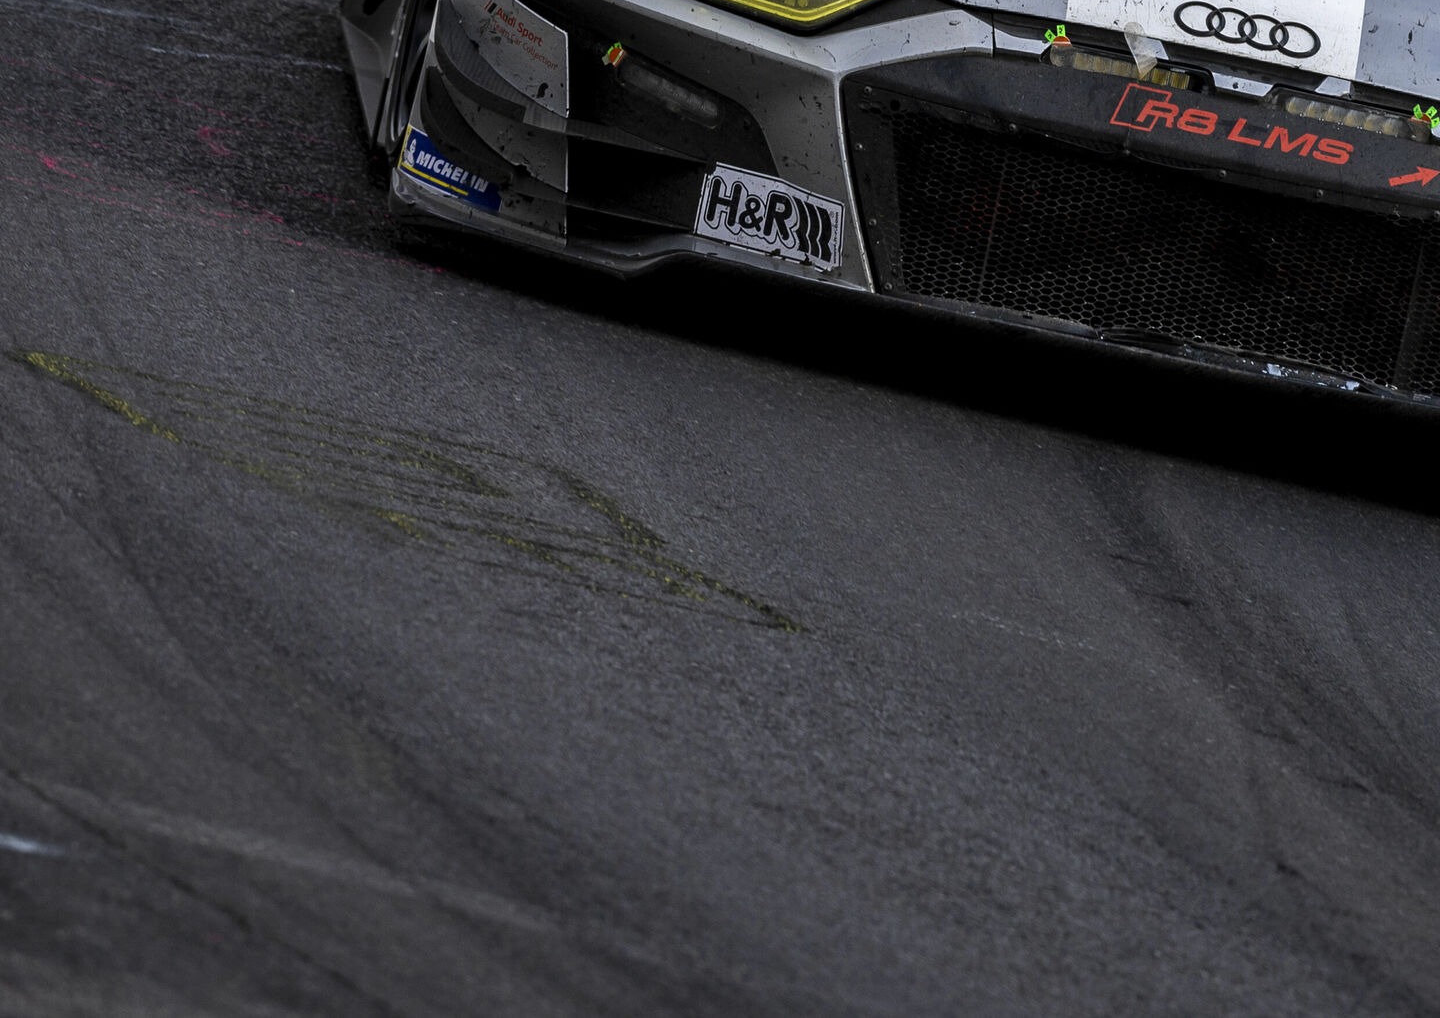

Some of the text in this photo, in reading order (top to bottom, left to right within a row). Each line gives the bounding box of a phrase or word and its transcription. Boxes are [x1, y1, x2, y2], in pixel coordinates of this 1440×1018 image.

[495, 7, 543, 47] Audi Sport
[1135, 99, 1354, 165] R8 LMS
[704, 175, 794, 249] H&R
